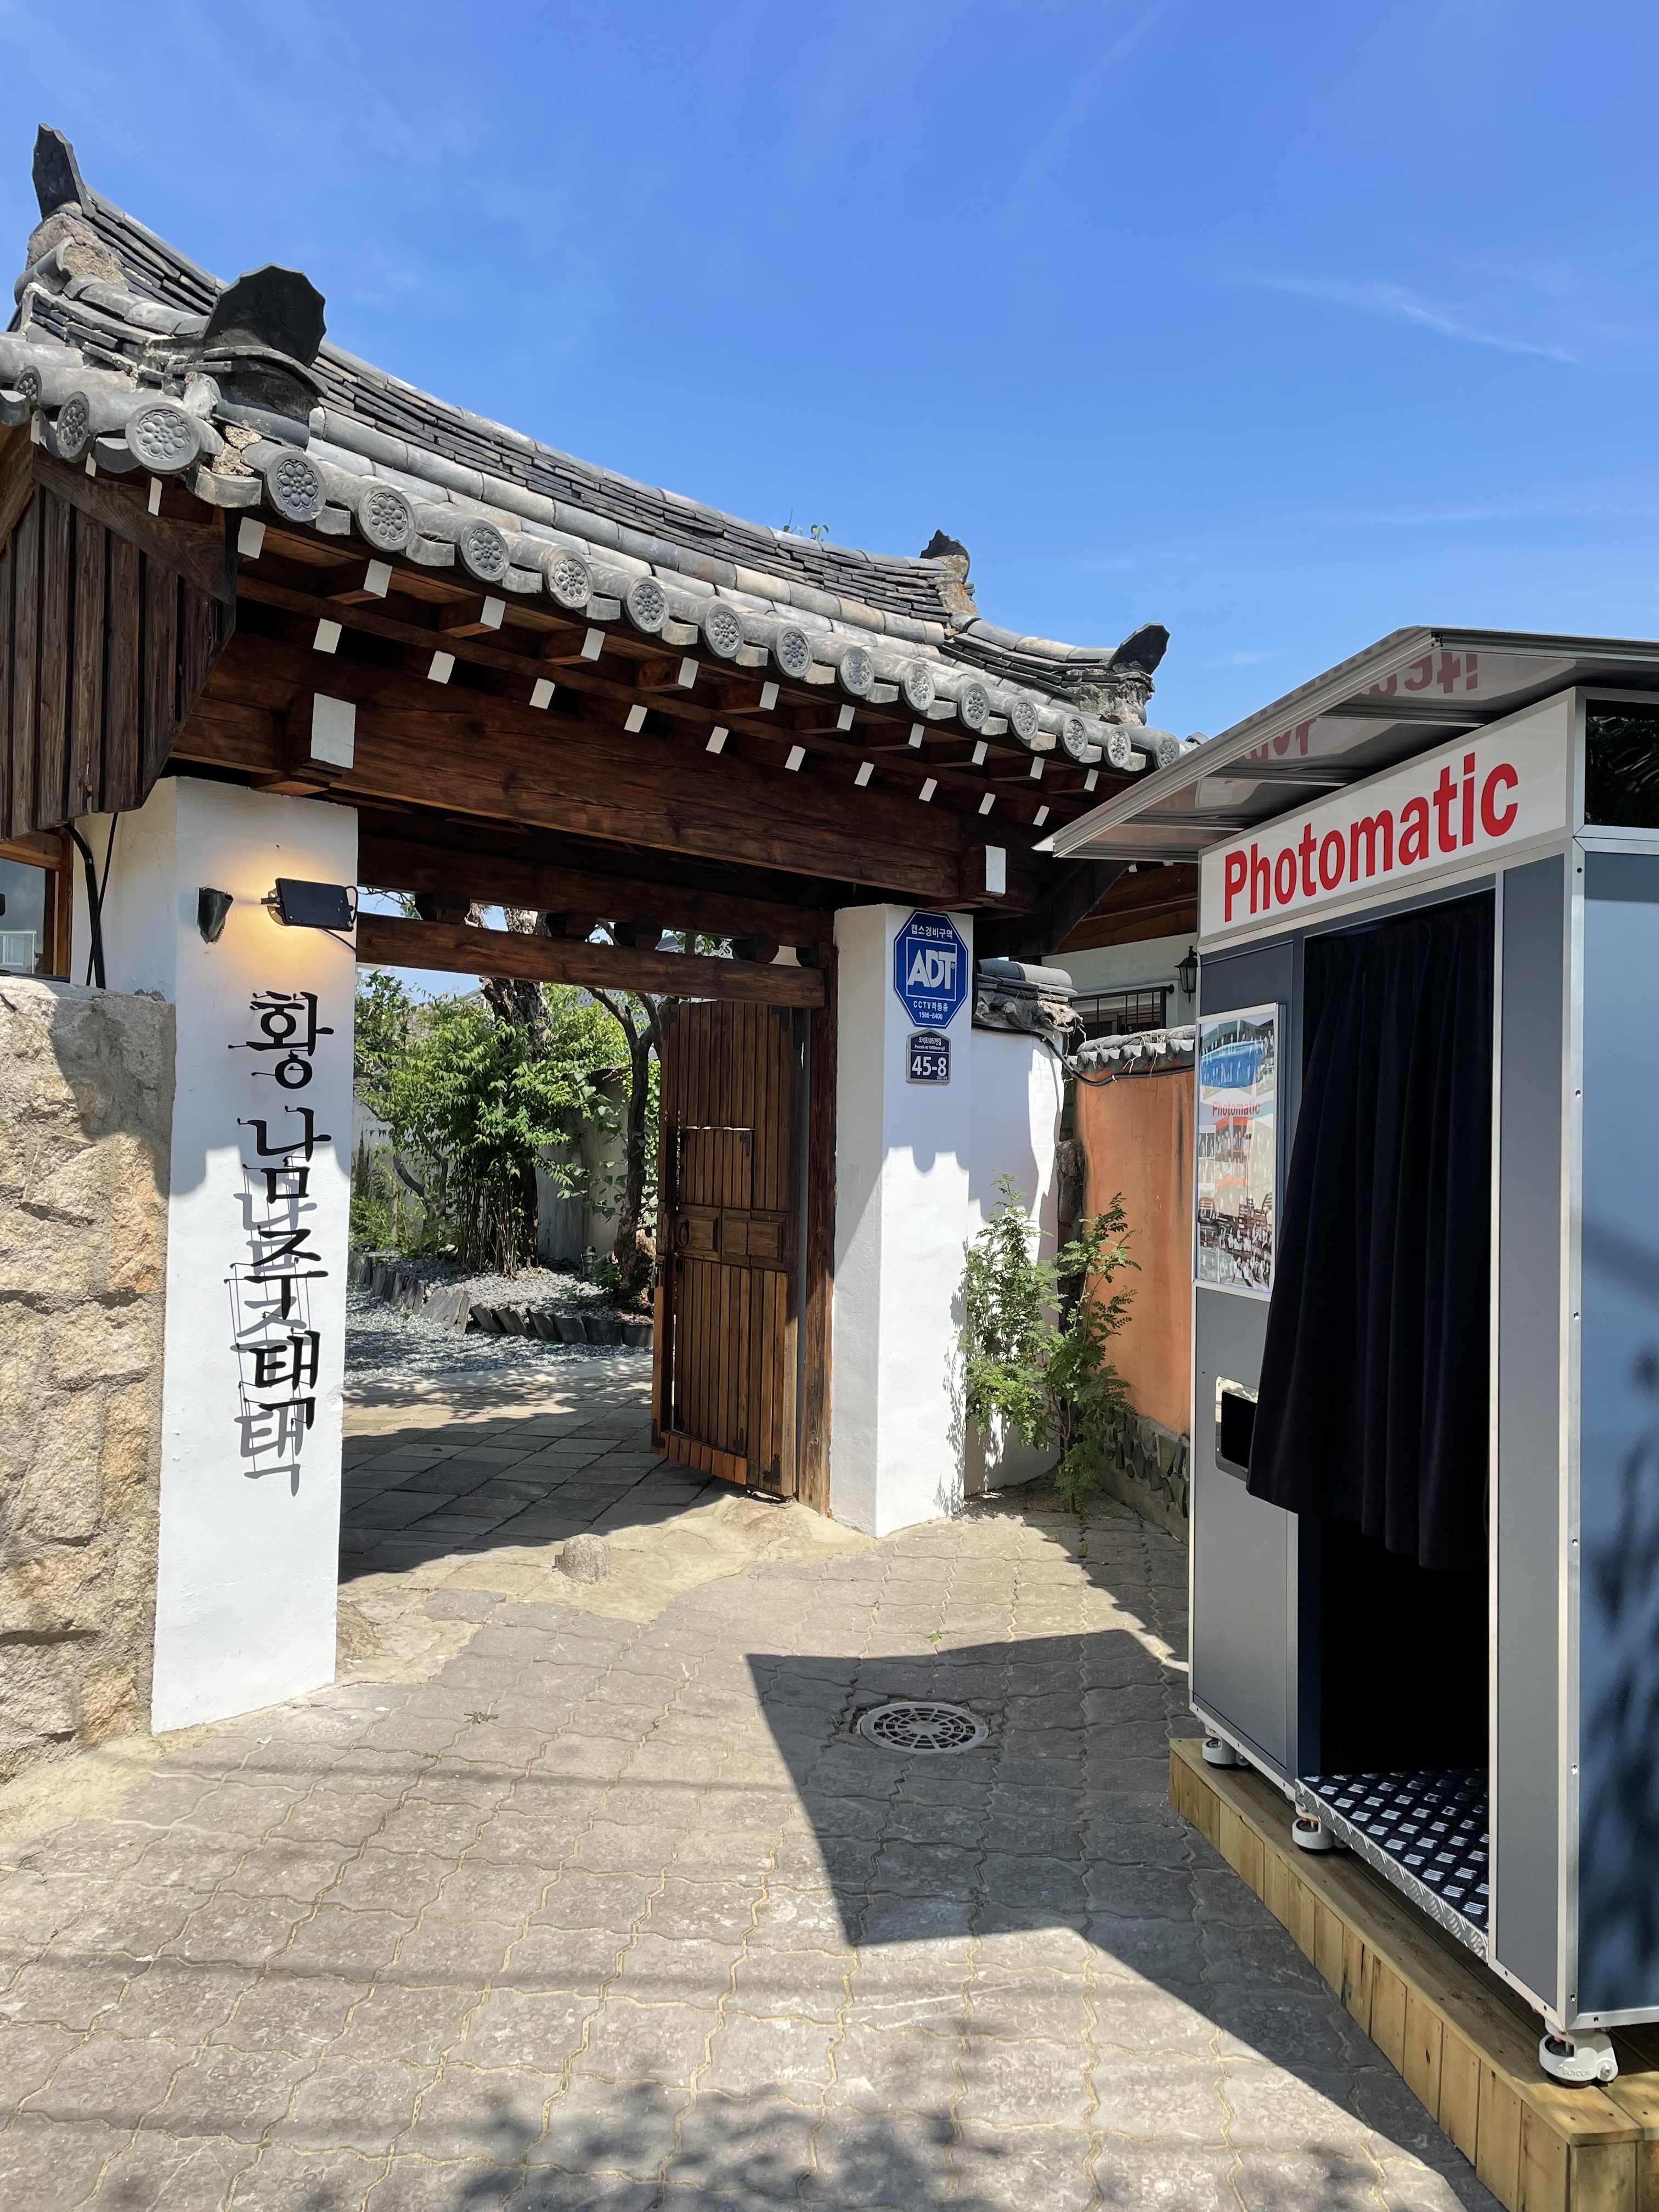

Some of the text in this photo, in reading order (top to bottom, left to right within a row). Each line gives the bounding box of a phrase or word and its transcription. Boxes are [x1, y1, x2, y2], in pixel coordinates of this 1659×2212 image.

[1224, 752, 1519, 923] Photomatic
[911, 924, 953, 940] 캡스경비구역
[907, 949, 956, 990] ADT
[919, 1012, 943, 1020] 1588-6400
[912, 1056, 947, 1076] 45-8
[1212, 1098, 1260, 1116] Photomatic
[245, 991, 334, 1431] 황남주택
